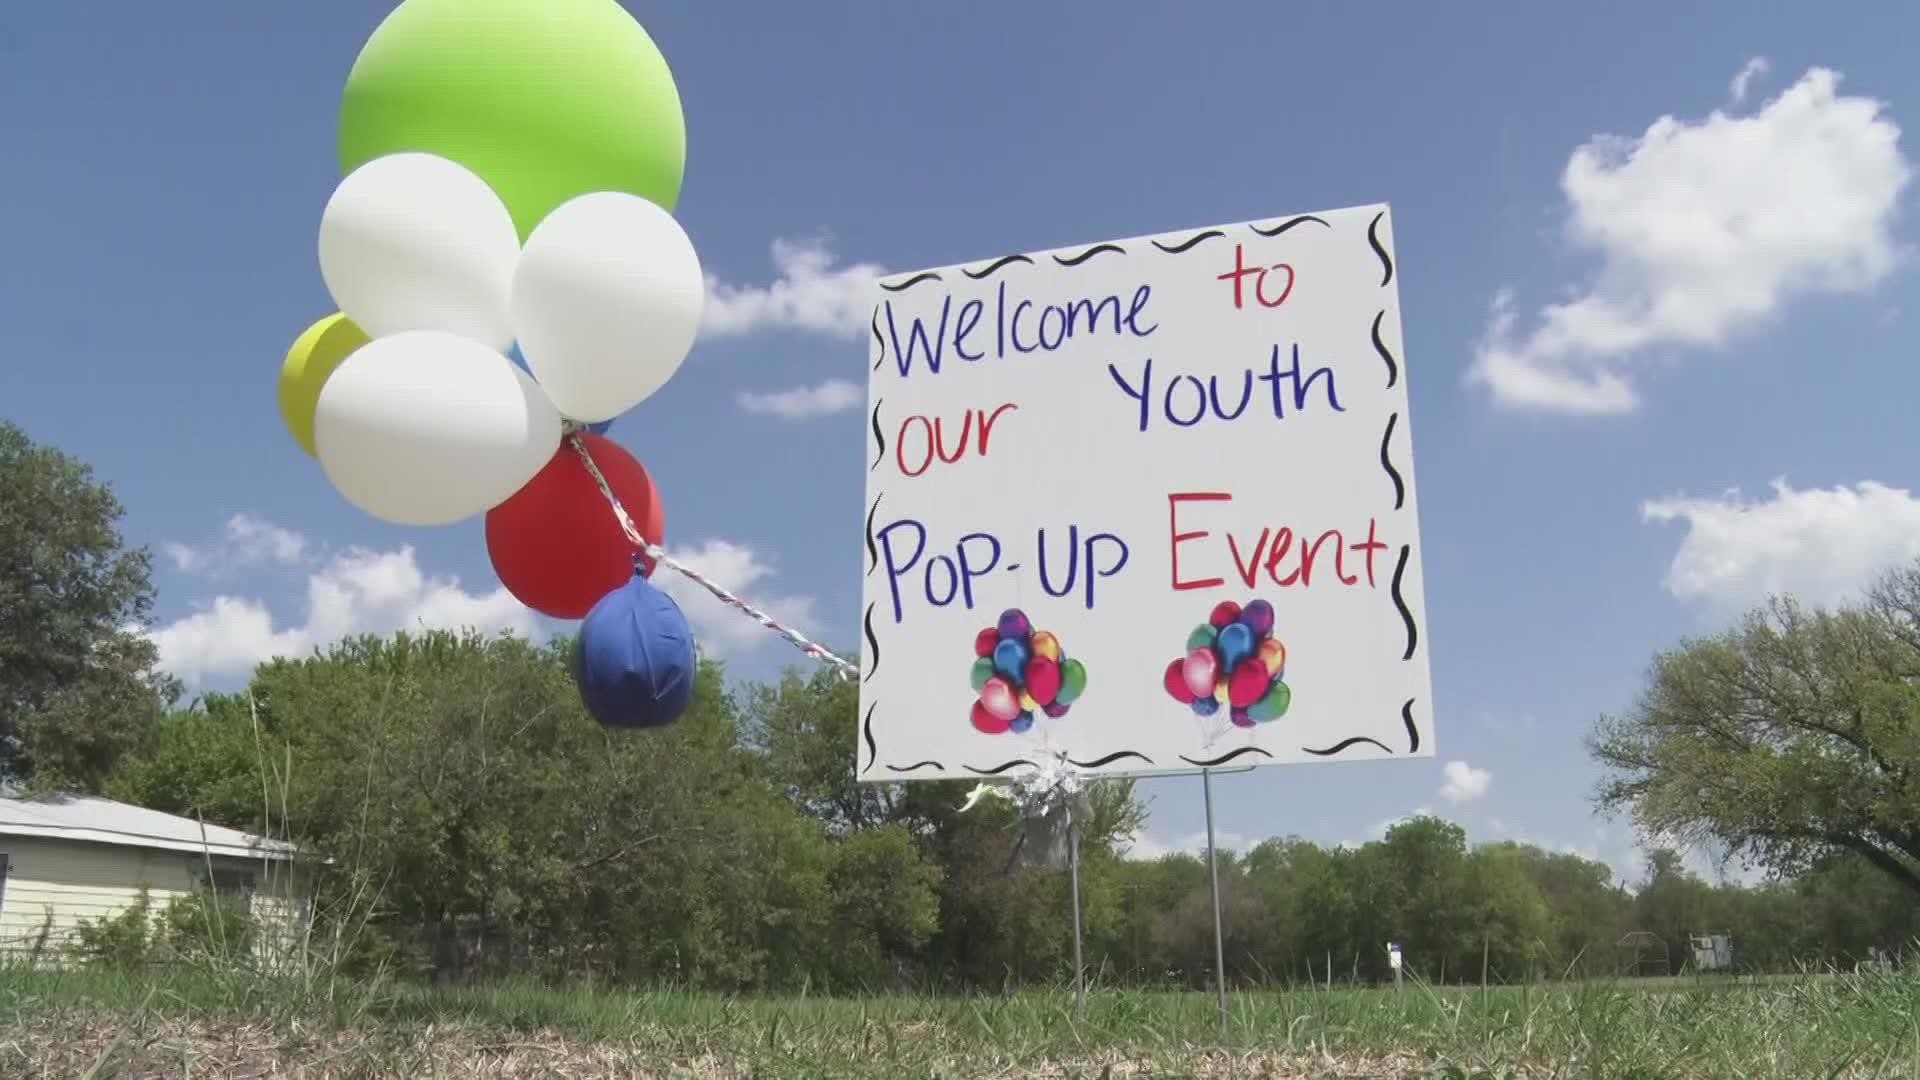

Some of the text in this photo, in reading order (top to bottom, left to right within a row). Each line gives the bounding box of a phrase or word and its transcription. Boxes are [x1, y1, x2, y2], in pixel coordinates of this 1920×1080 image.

[886, 244, 1294, 377] Welcome to
[897, 343, 1346, 476] our Youth
[1168, 493, 1388, 591] Event
